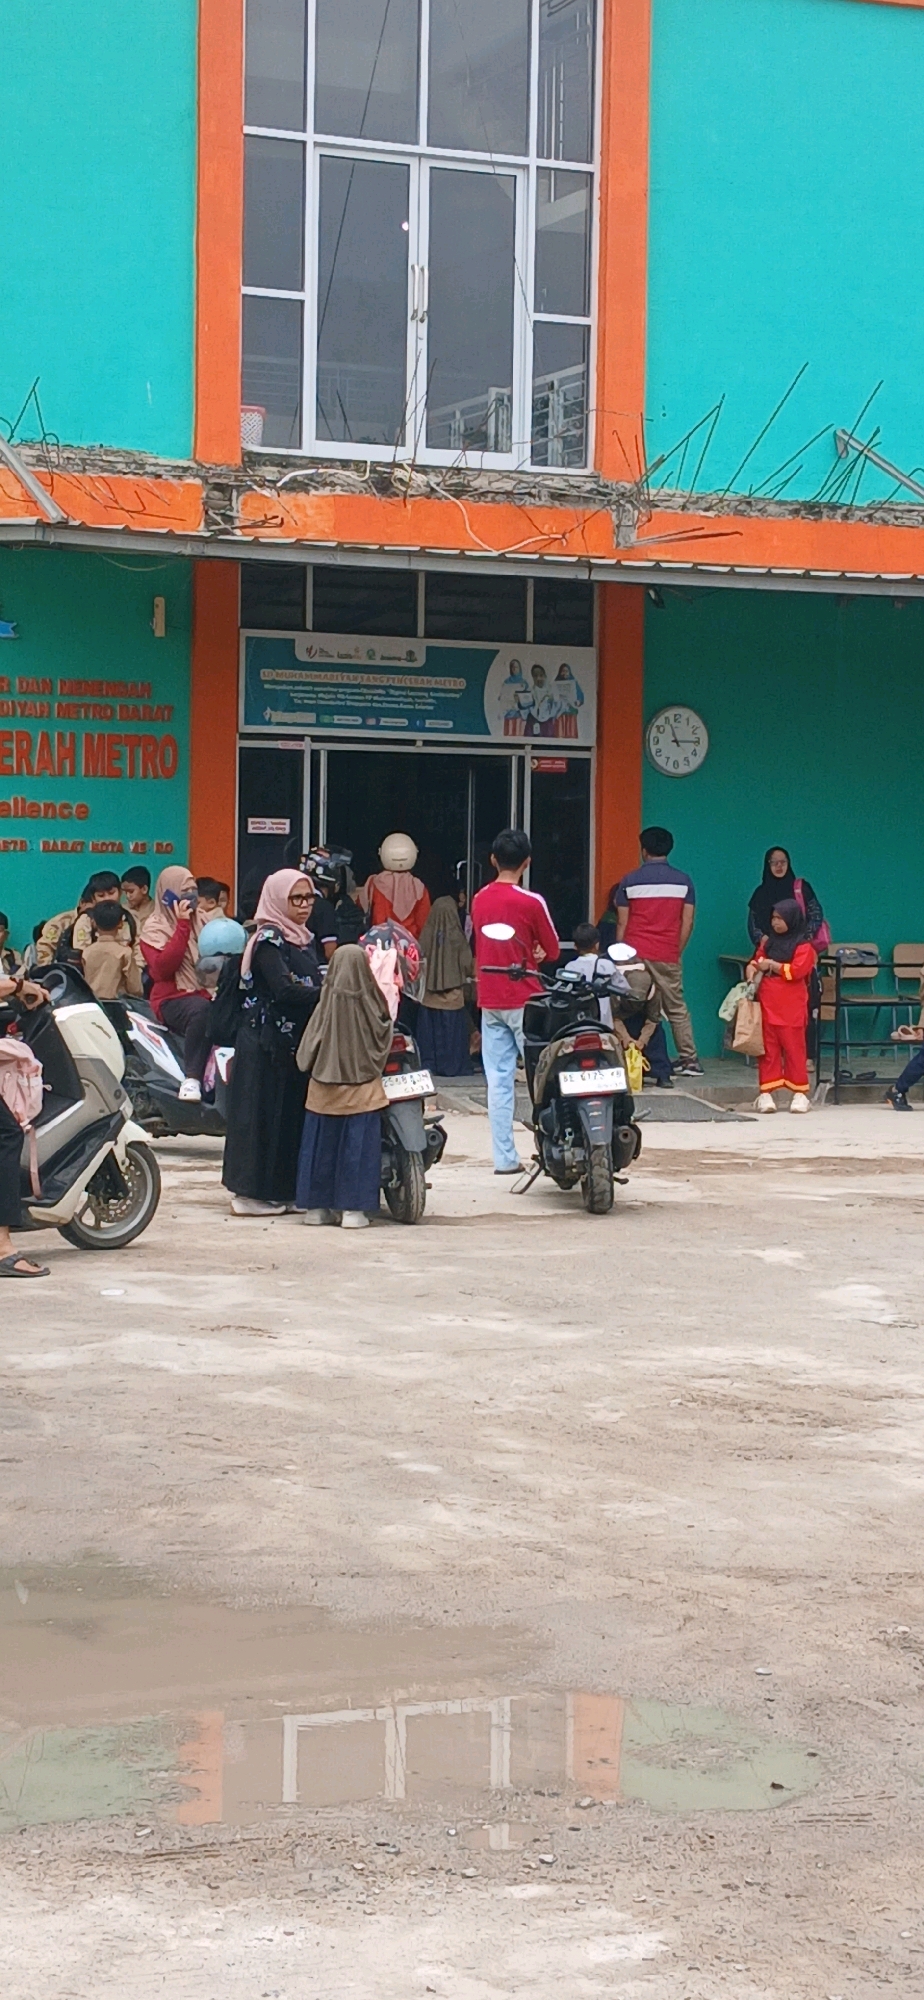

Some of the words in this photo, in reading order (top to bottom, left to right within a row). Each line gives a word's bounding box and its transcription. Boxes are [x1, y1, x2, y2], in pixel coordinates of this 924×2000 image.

[16, 676, 52, 695] DAN
[57, 678, 152, 699] MENENGAH
[55, 702, 114, 721] METRO
[118, 703, 174, 722] BARAT
[0, 730, 76, 777] ERAH
[83, 732, 178, 779] METRO
